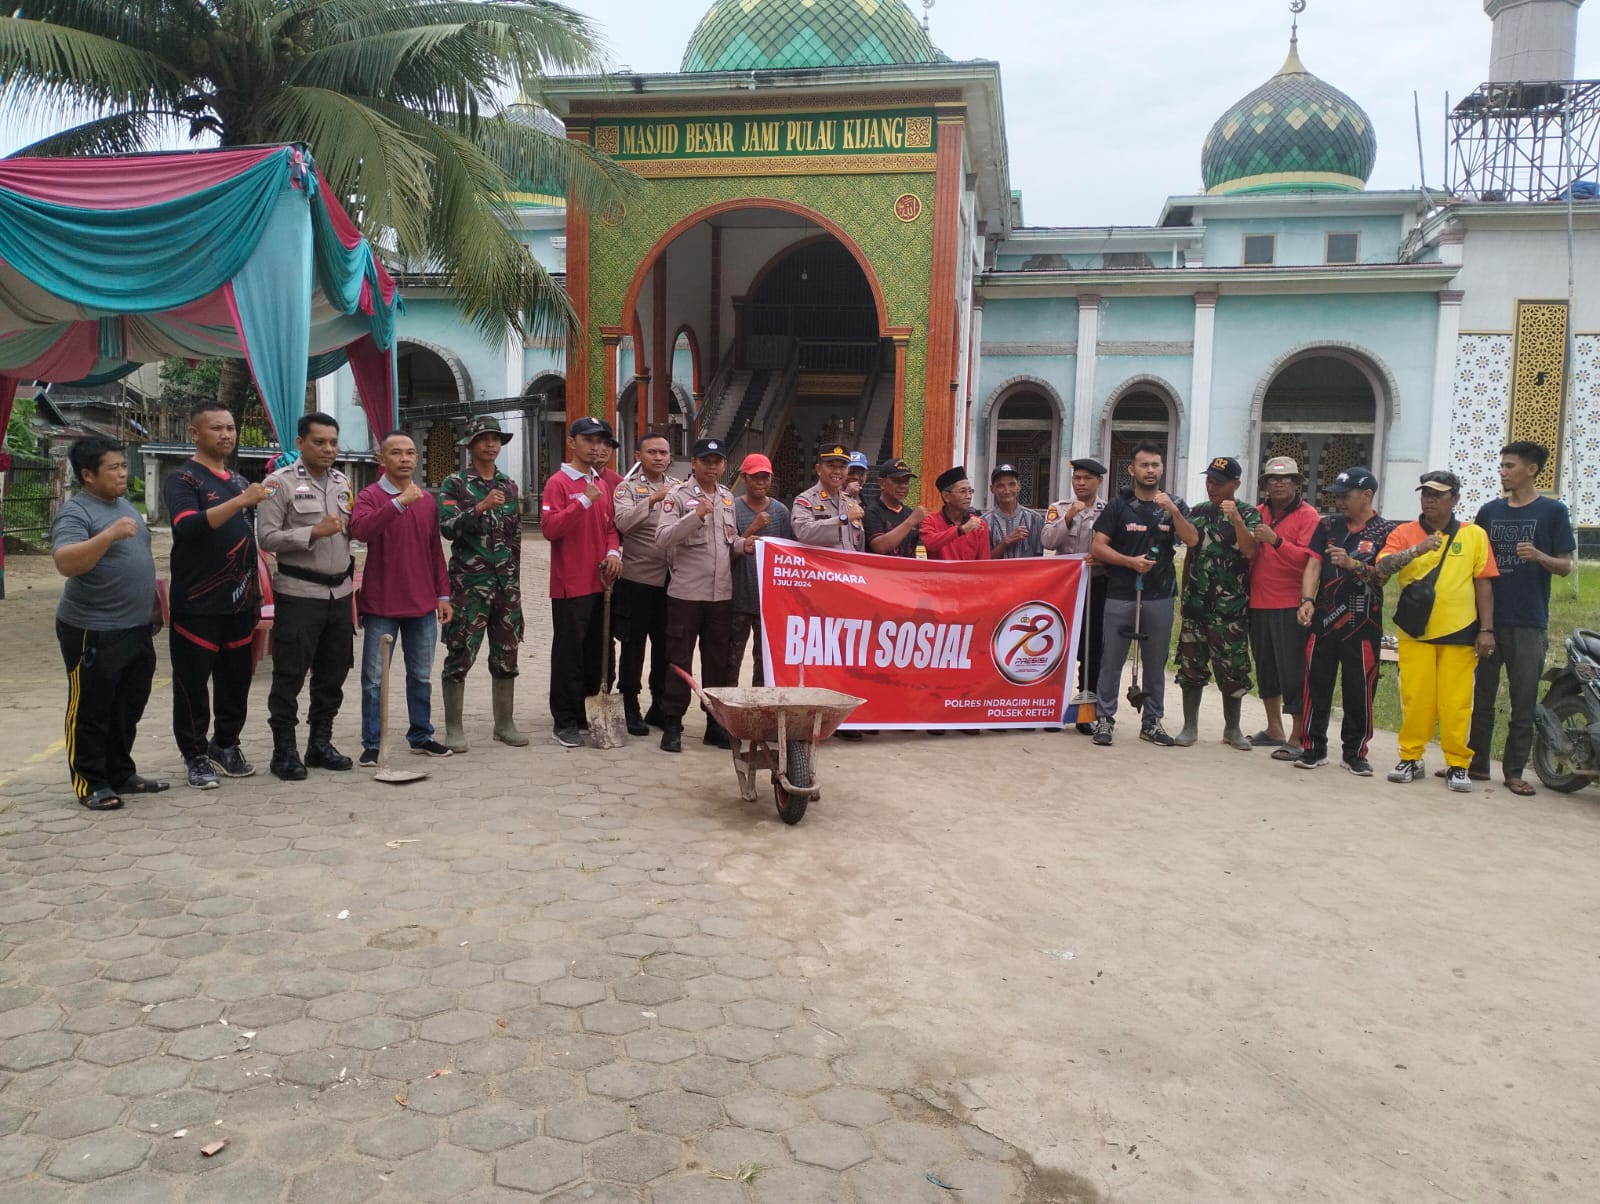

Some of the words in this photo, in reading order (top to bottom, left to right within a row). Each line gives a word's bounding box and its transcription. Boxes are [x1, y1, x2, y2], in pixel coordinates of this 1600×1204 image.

[623, 124, 679, 154] MASJID
[685, 122, 735, 153] BESAR
[786, 120, 837, 151] PULAU
[843, 117, 903, 149] KIJANG
[774, 554, 805, 566] HARI
[773, 567, 866, 584] BHAYANGKARA
[784, 615, 872, 666] BAKTI
[875, 620, 974, 669] SOSIAL
[944, 699, 981, 708] POLRES
[983, 699, 1030, 707] INDRAGIRI
[1032, 698, 1056, 707] HILIR
[987, 708, 1023, 717] POLSEK
[1025, 708, 1055, 717] RETEH
